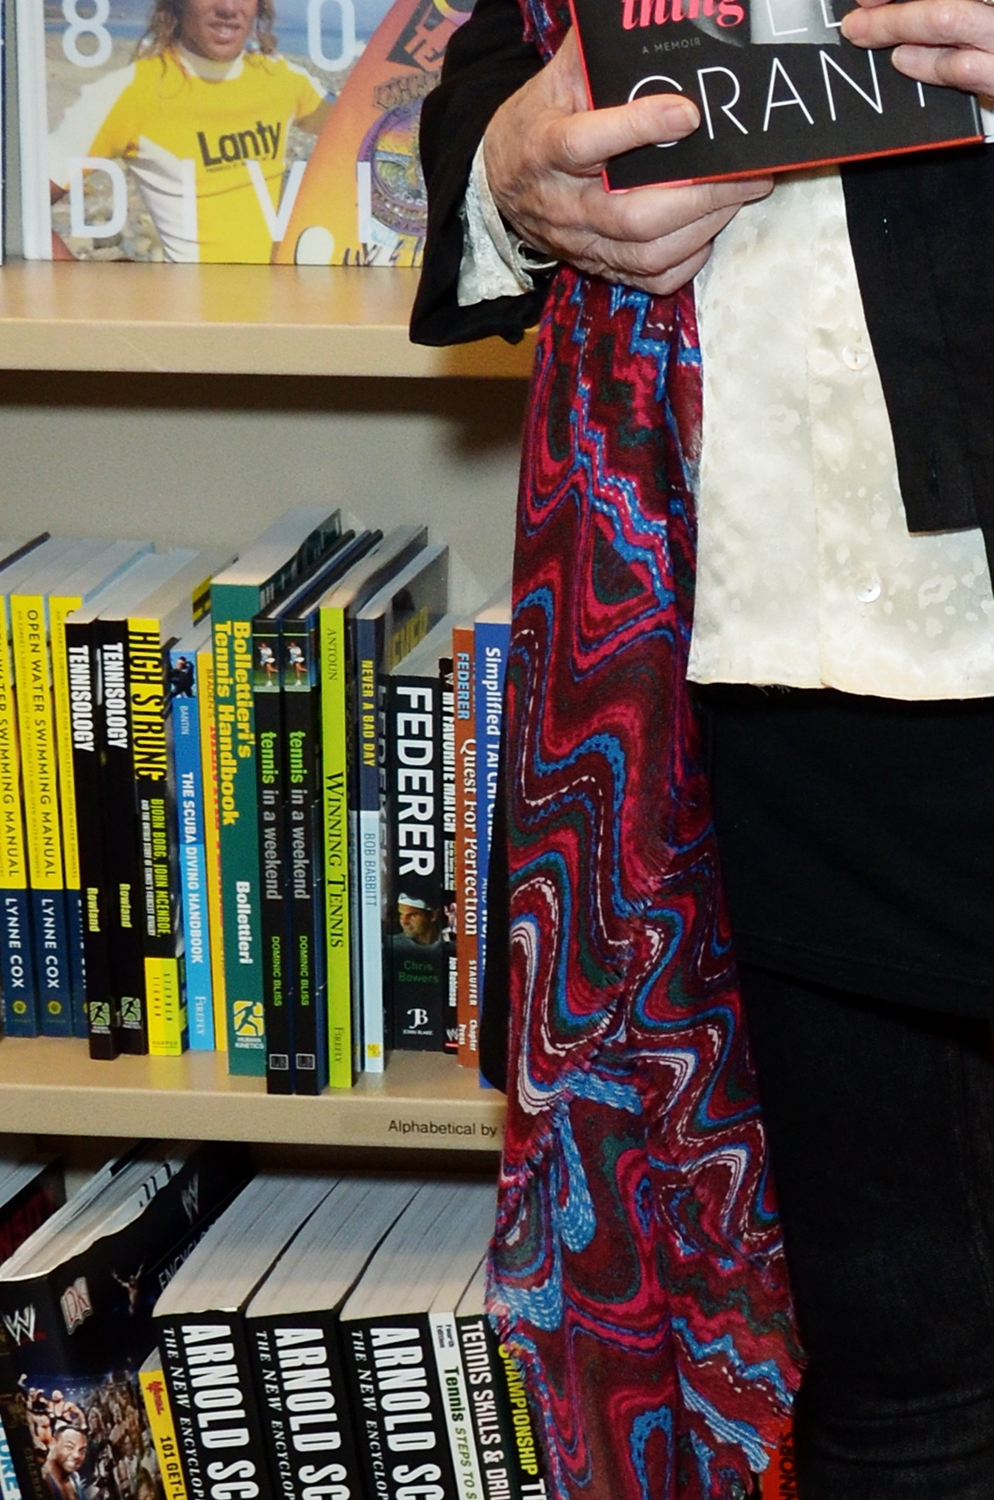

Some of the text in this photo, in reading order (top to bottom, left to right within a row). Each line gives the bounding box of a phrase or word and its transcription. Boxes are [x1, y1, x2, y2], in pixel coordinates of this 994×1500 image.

[642, 37, 702, 55] A MEMOIR
[628, 49, 927, 149] RAN
[196, 120, 282, 167] Lanty
[27, 609, 41, 653] OPEN
[128, 631, 163, 686] HIGH
[214, 620, 234, 698] Tennis
[31, 660, 45, 712] WATER
[103, 642, 128, 749] TENNISOLOGY
[233, 621, 256, 759] Bollettieri's
[361, 660, 376, 767] NEVER A BAD DAY
[457, 652, 471, 721] FEDERER
[482, 647, 502, 736] Simplified
[34, 719, 51, 805] SWIMMING
[131, 693, 168, 781] STRUNG
[218, 704, 240, 826] Handbook
[459, 739, 477, 793] Quest
[396, 686, 436, 876] FEDERER
[41, 812, 56, 878] MANUAL
[181, 772, 204, 964] THE SCUBA DIVING HANDBOOK
[260, 731, 283, 1007] tennis in a weekend DOMINIC BLISS
[325, 771, 348, 949] WINNING TENNIS
[41, 898, 57, 949] LYNNE
[236, 881, 254, 965] Bollettieri
[45, 955, 60, 989] COX
[398, 972, 440, 985] Bowers
[404, 959, 434, 971] Chris
[388, 1120, 498, 1138] Alphabetical by
[163, 1328, 192, 1409] THE NEW
[181, 1325, 250, 1449] ARNOLD
[274, 1328, 342, 1453] ARNOLD
[370, 1328, 437, 1452] ARNOLD
[444, 1366, 476, 1489] Tennis STEPS TO
[473, 1389, 502, 1445] SKILLS
[482, 1450, 505, 1464] &
